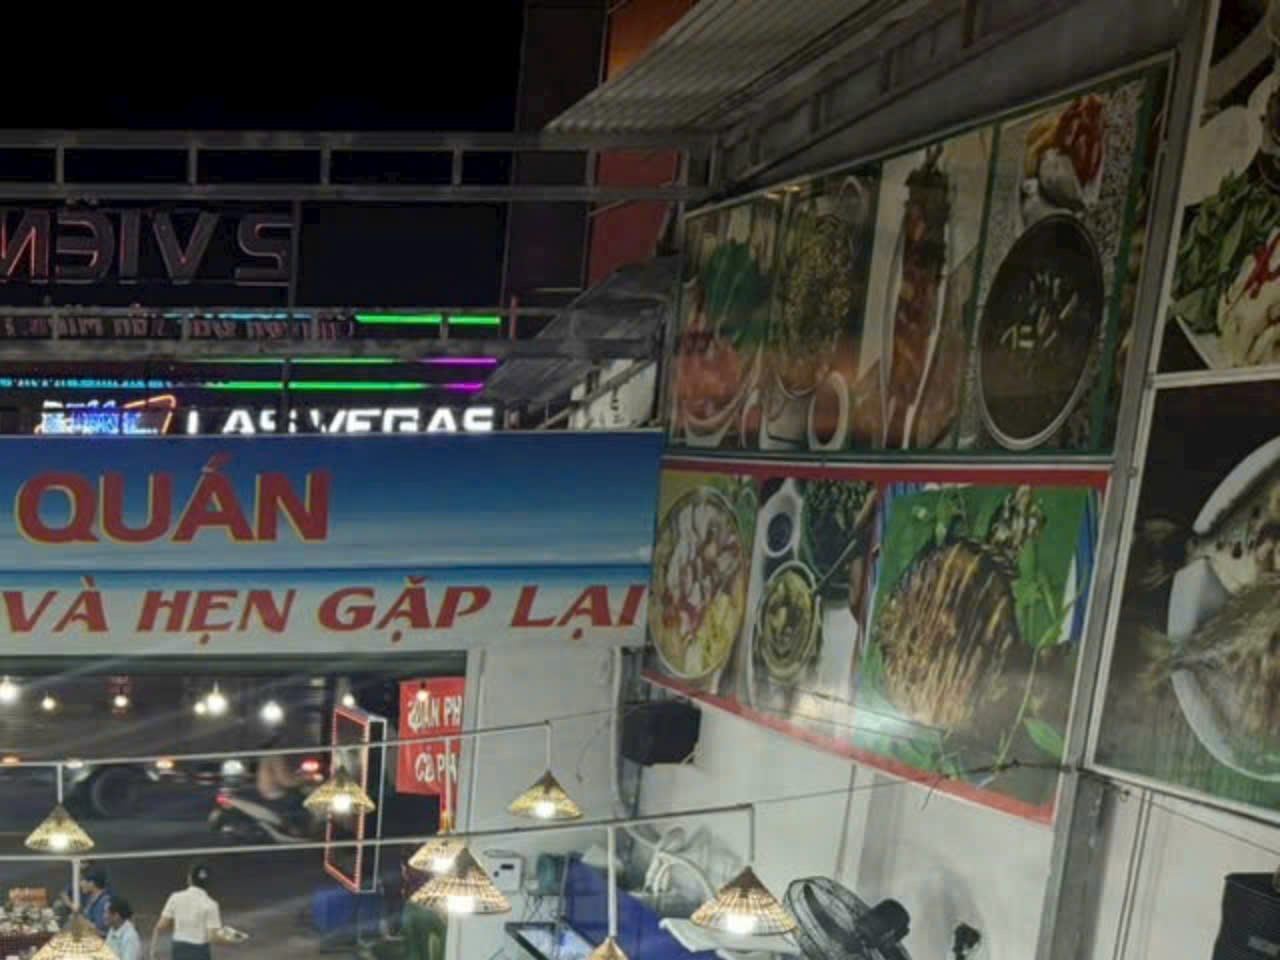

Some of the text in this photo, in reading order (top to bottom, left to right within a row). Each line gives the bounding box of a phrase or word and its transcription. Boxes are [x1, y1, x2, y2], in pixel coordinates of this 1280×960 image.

[14, 453, 331, 543] QUÁN
[2, 576, 108, 632] VÀ
[135, 589, 296, 645] HẸN
[317, 575, 491, 643] GẶP
[509, 585, 647, 640] LẠI
